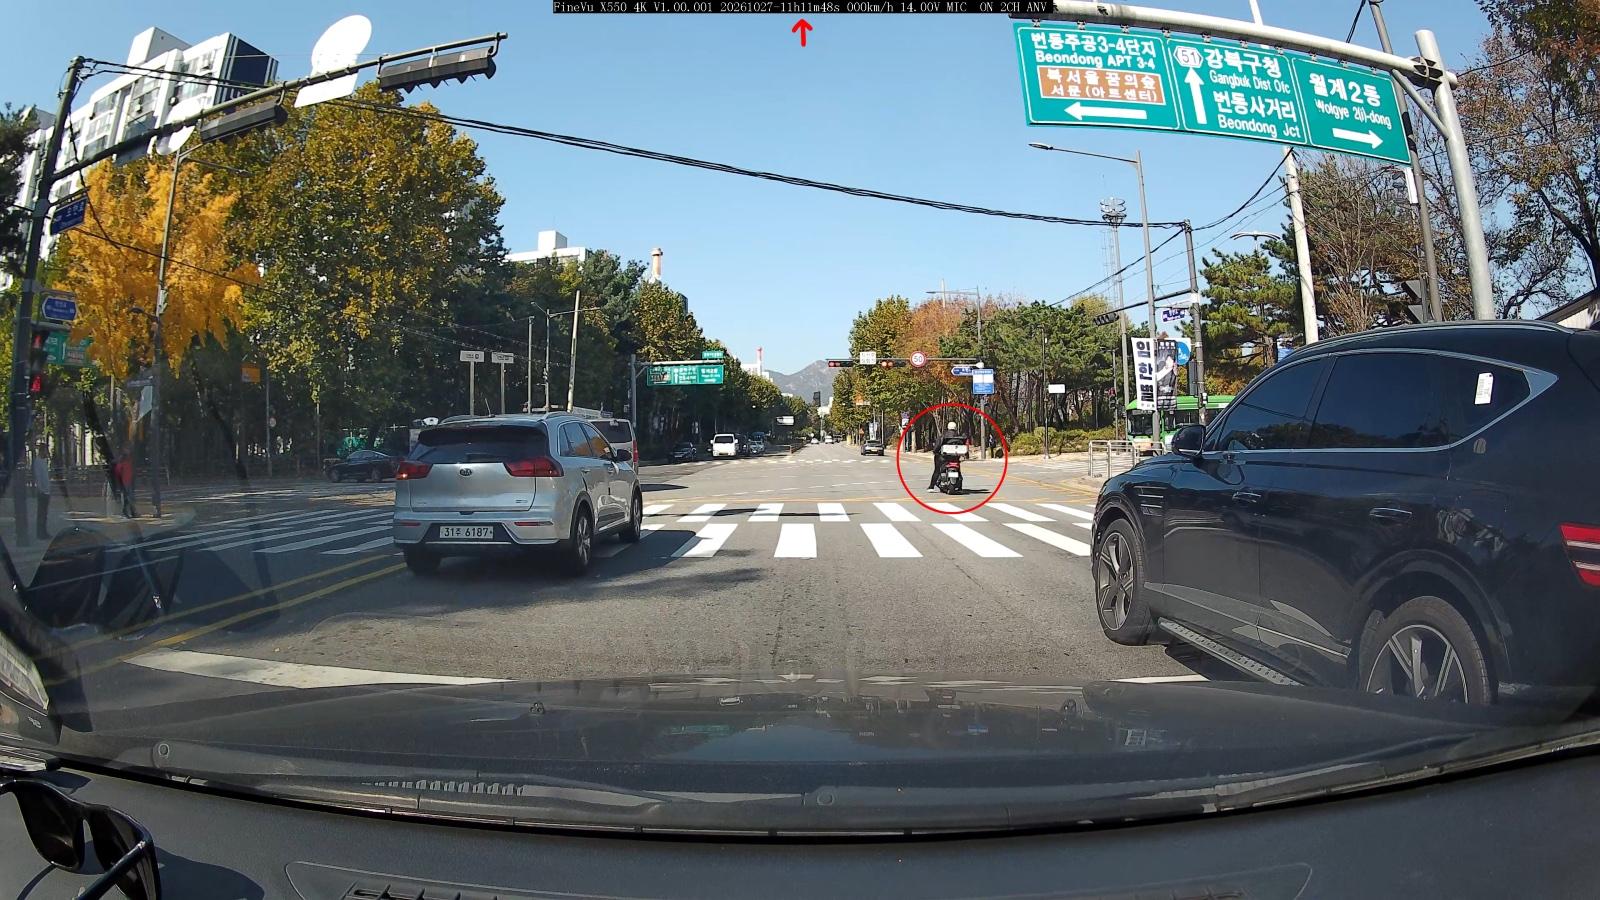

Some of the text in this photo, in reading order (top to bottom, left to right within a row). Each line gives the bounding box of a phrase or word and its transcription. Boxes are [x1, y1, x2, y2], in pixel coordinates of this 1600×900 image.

[1031, 32, 1157, 58] 번동주공3-4단지
[1181, 49, 1197, 64] 51
[1035, 50, 1156, 70] Beondong APT 3-4
[1204, 48, 1282, 79] 강북구청
[1209, 69, 1291, 94] Gangbuk Dist Ofc
[1309, 72, 1381, 107] 월계2동
[1213, 91, 1298, 122] 번동사거리
[1314, 98, 1350, 120] Wolgye
[1218, 114, 1301, 138] Beondong Jct
[465, 527, 489, 537] 6187
